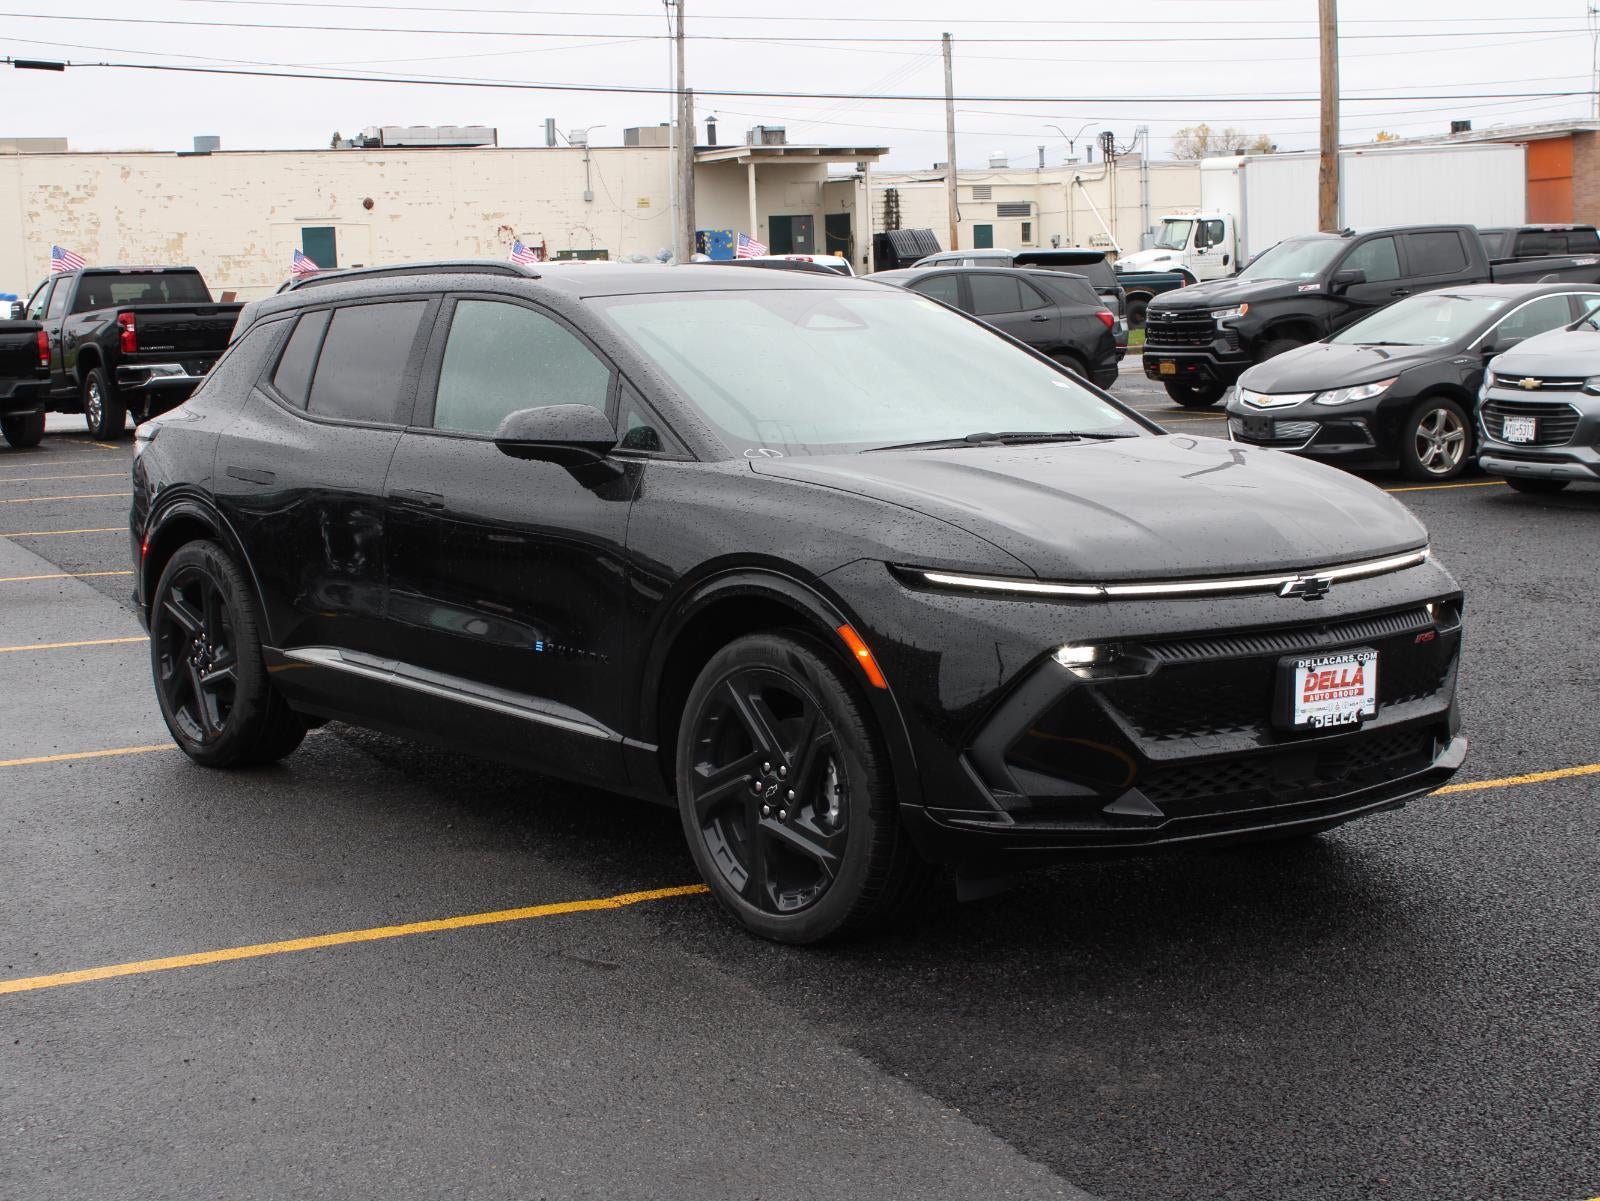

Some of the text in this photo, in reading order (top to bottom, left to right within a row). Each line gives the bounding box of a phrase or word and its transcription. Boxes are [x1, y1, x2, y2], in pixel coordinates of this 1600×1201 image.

[1298, 652, 1377, 668] DELLACARS.COM
[1304, 666, 1364, 692] DELLA
[1309, 689, 1359, 701] AUTO GROUP
[1315, 712, 1358, 728] DELLA
